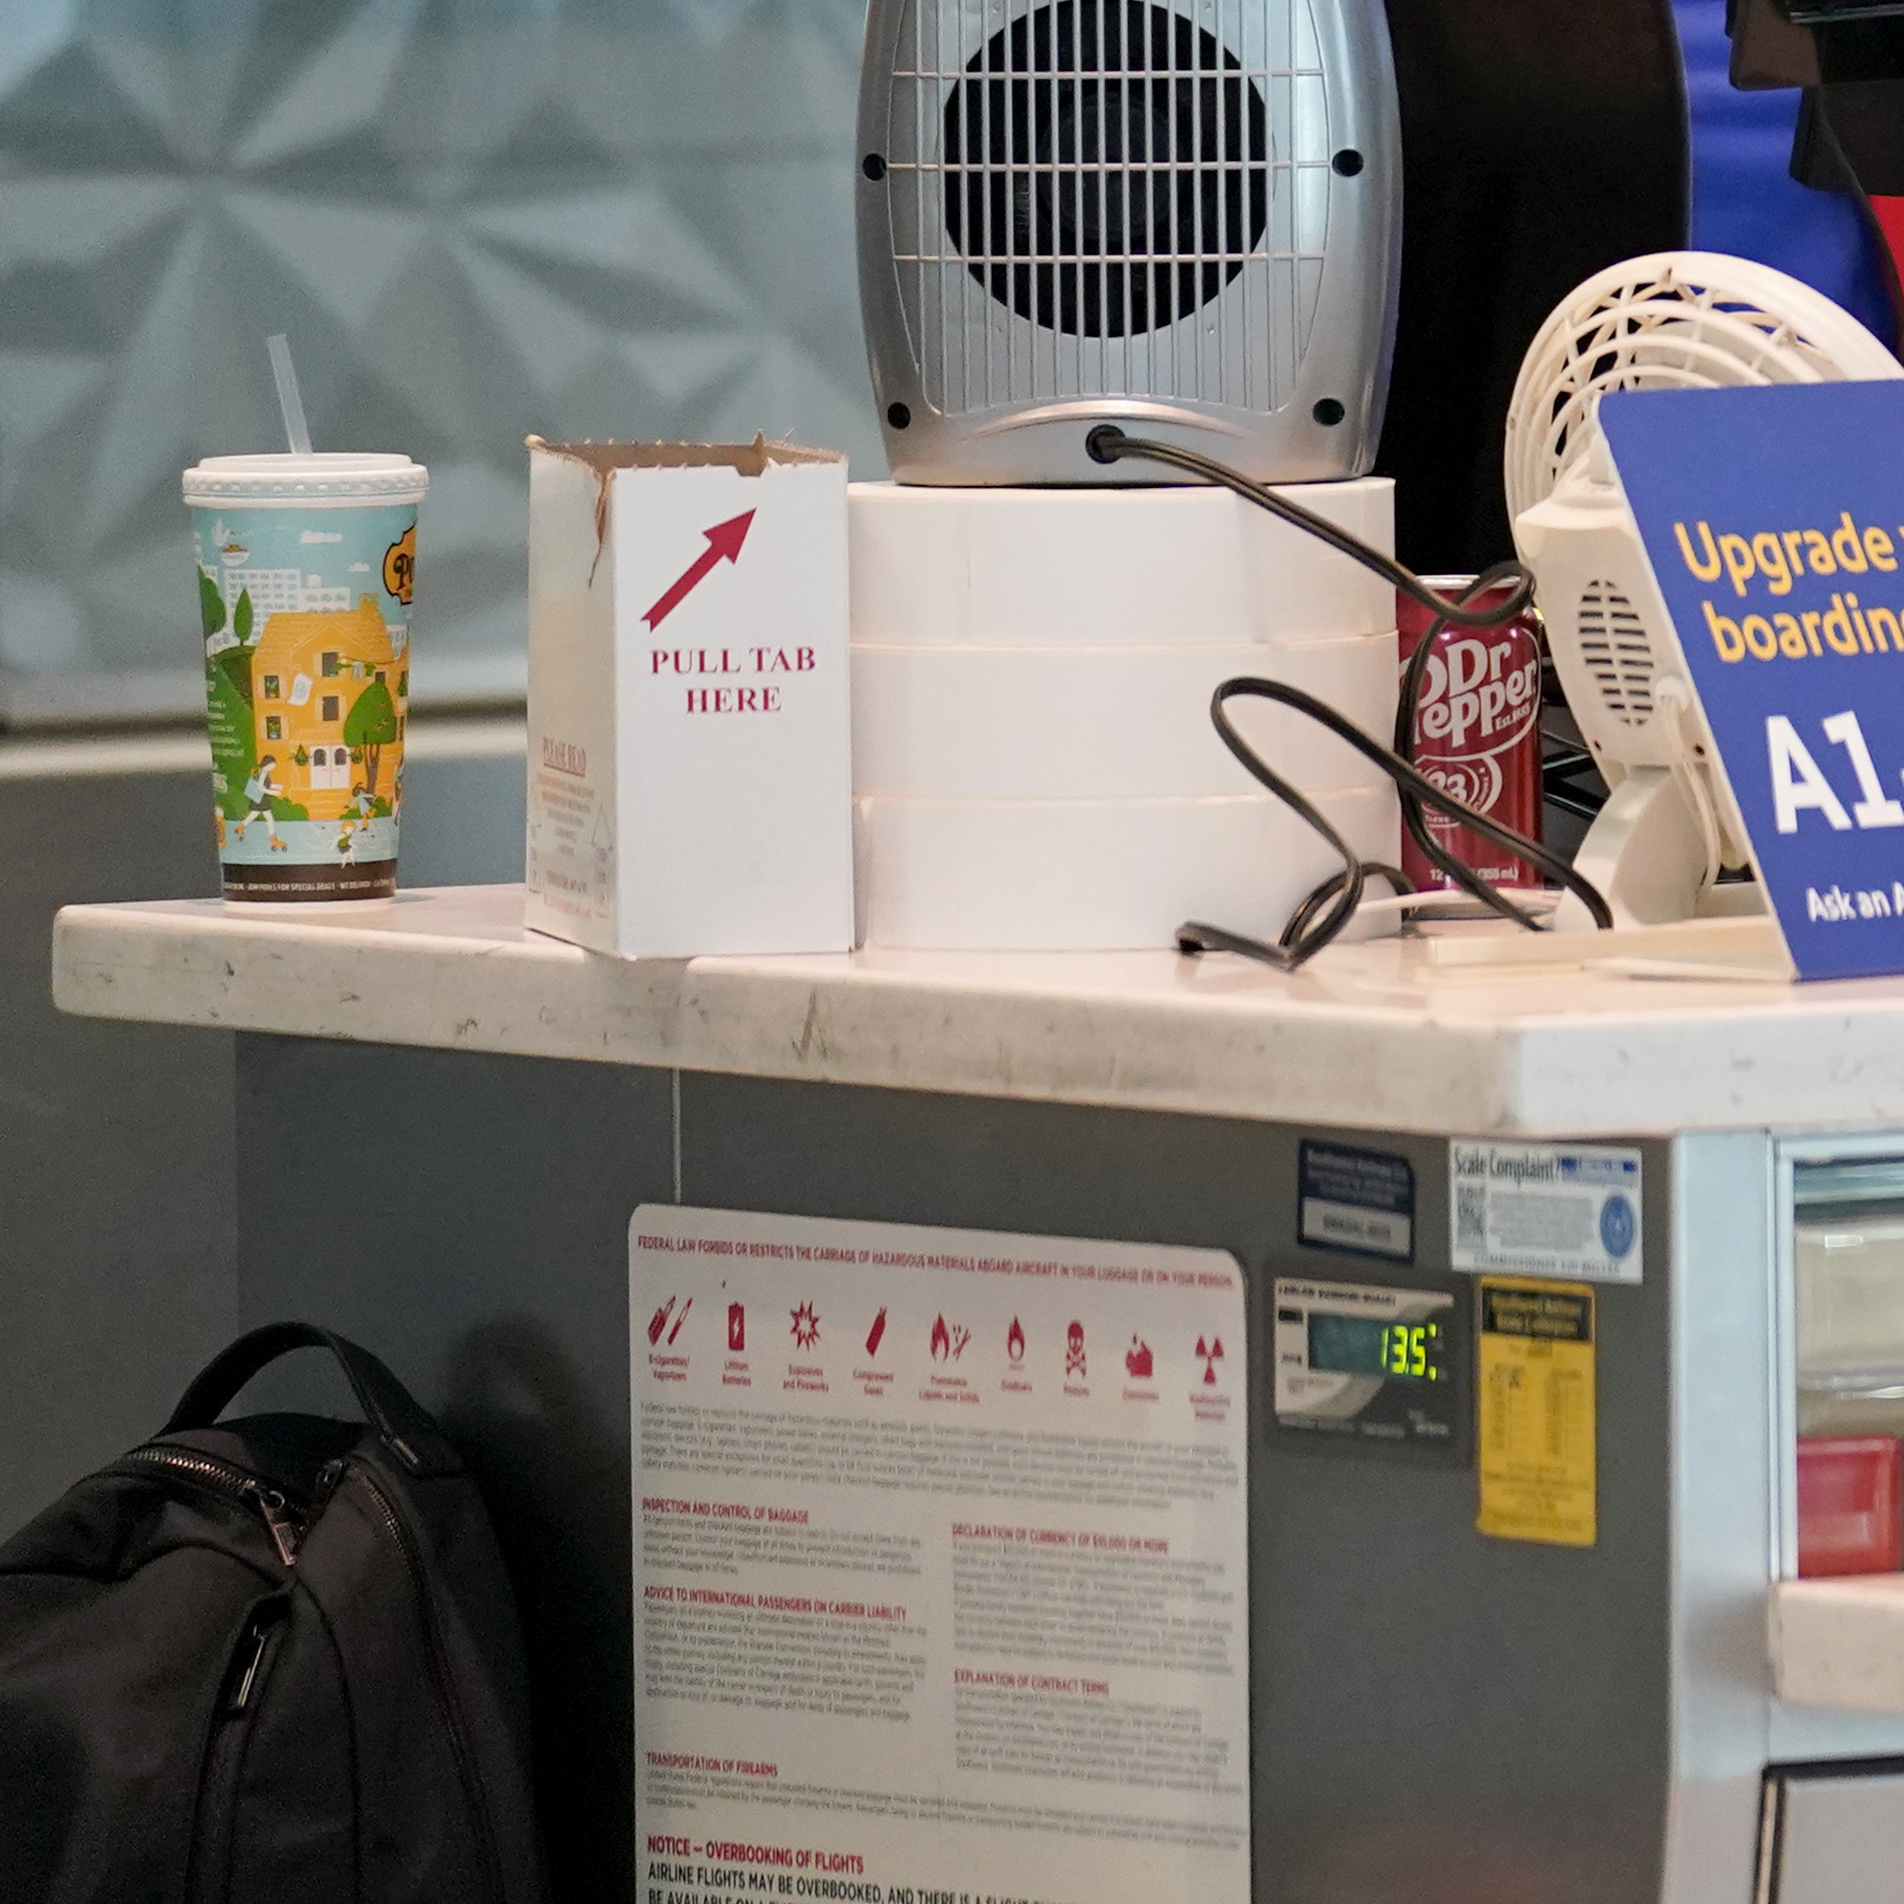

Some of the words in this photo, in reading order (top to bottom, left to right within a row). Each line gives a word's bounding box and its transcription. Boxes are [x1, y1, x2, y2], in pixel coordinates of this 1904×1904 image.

[1674, 512, 1898, 597] Upgrade
[651, 647, 742, 675] PULL
[749, 645, 816, 673] TAB
[1445, 639, 1512, 699] Dr
[687, 685, 782, 715] HERE
[1806, 885, 1854, 922] Ask
[1857, 889, 1891, 916] an
[1454, 1146, 1487, 1177] Scale
[1489, 1150, 1562, 1188] Complaint?
[677, 1237, 696, 1252] LAW
[644, 1585, 674, 1601] ADVICE
[676, 1587, 688, 1602] TO
[688, 1588, 757, 1609] INTERNATIONAL
[722, 1756, 735, 1773] OF
[647, 1835, 691, 1857] NOTICE
[705, 1840, 794, 1868] OVERBOOKING
[795, 1851, 812, 1869] OF
[814, 1853, 865, 1875] FLIGHTS
[647, 1862, 694, 1885] AIRLINE
[696, 1866, 746, 1891] FLIGHTS
[748, 1871, 775, 1893] MAY
[778, 1875, 793, 1896] BE
[796, 1876, 884, 1904] OVERBOOKED,
[887, 1885, 915, 1904] AND
